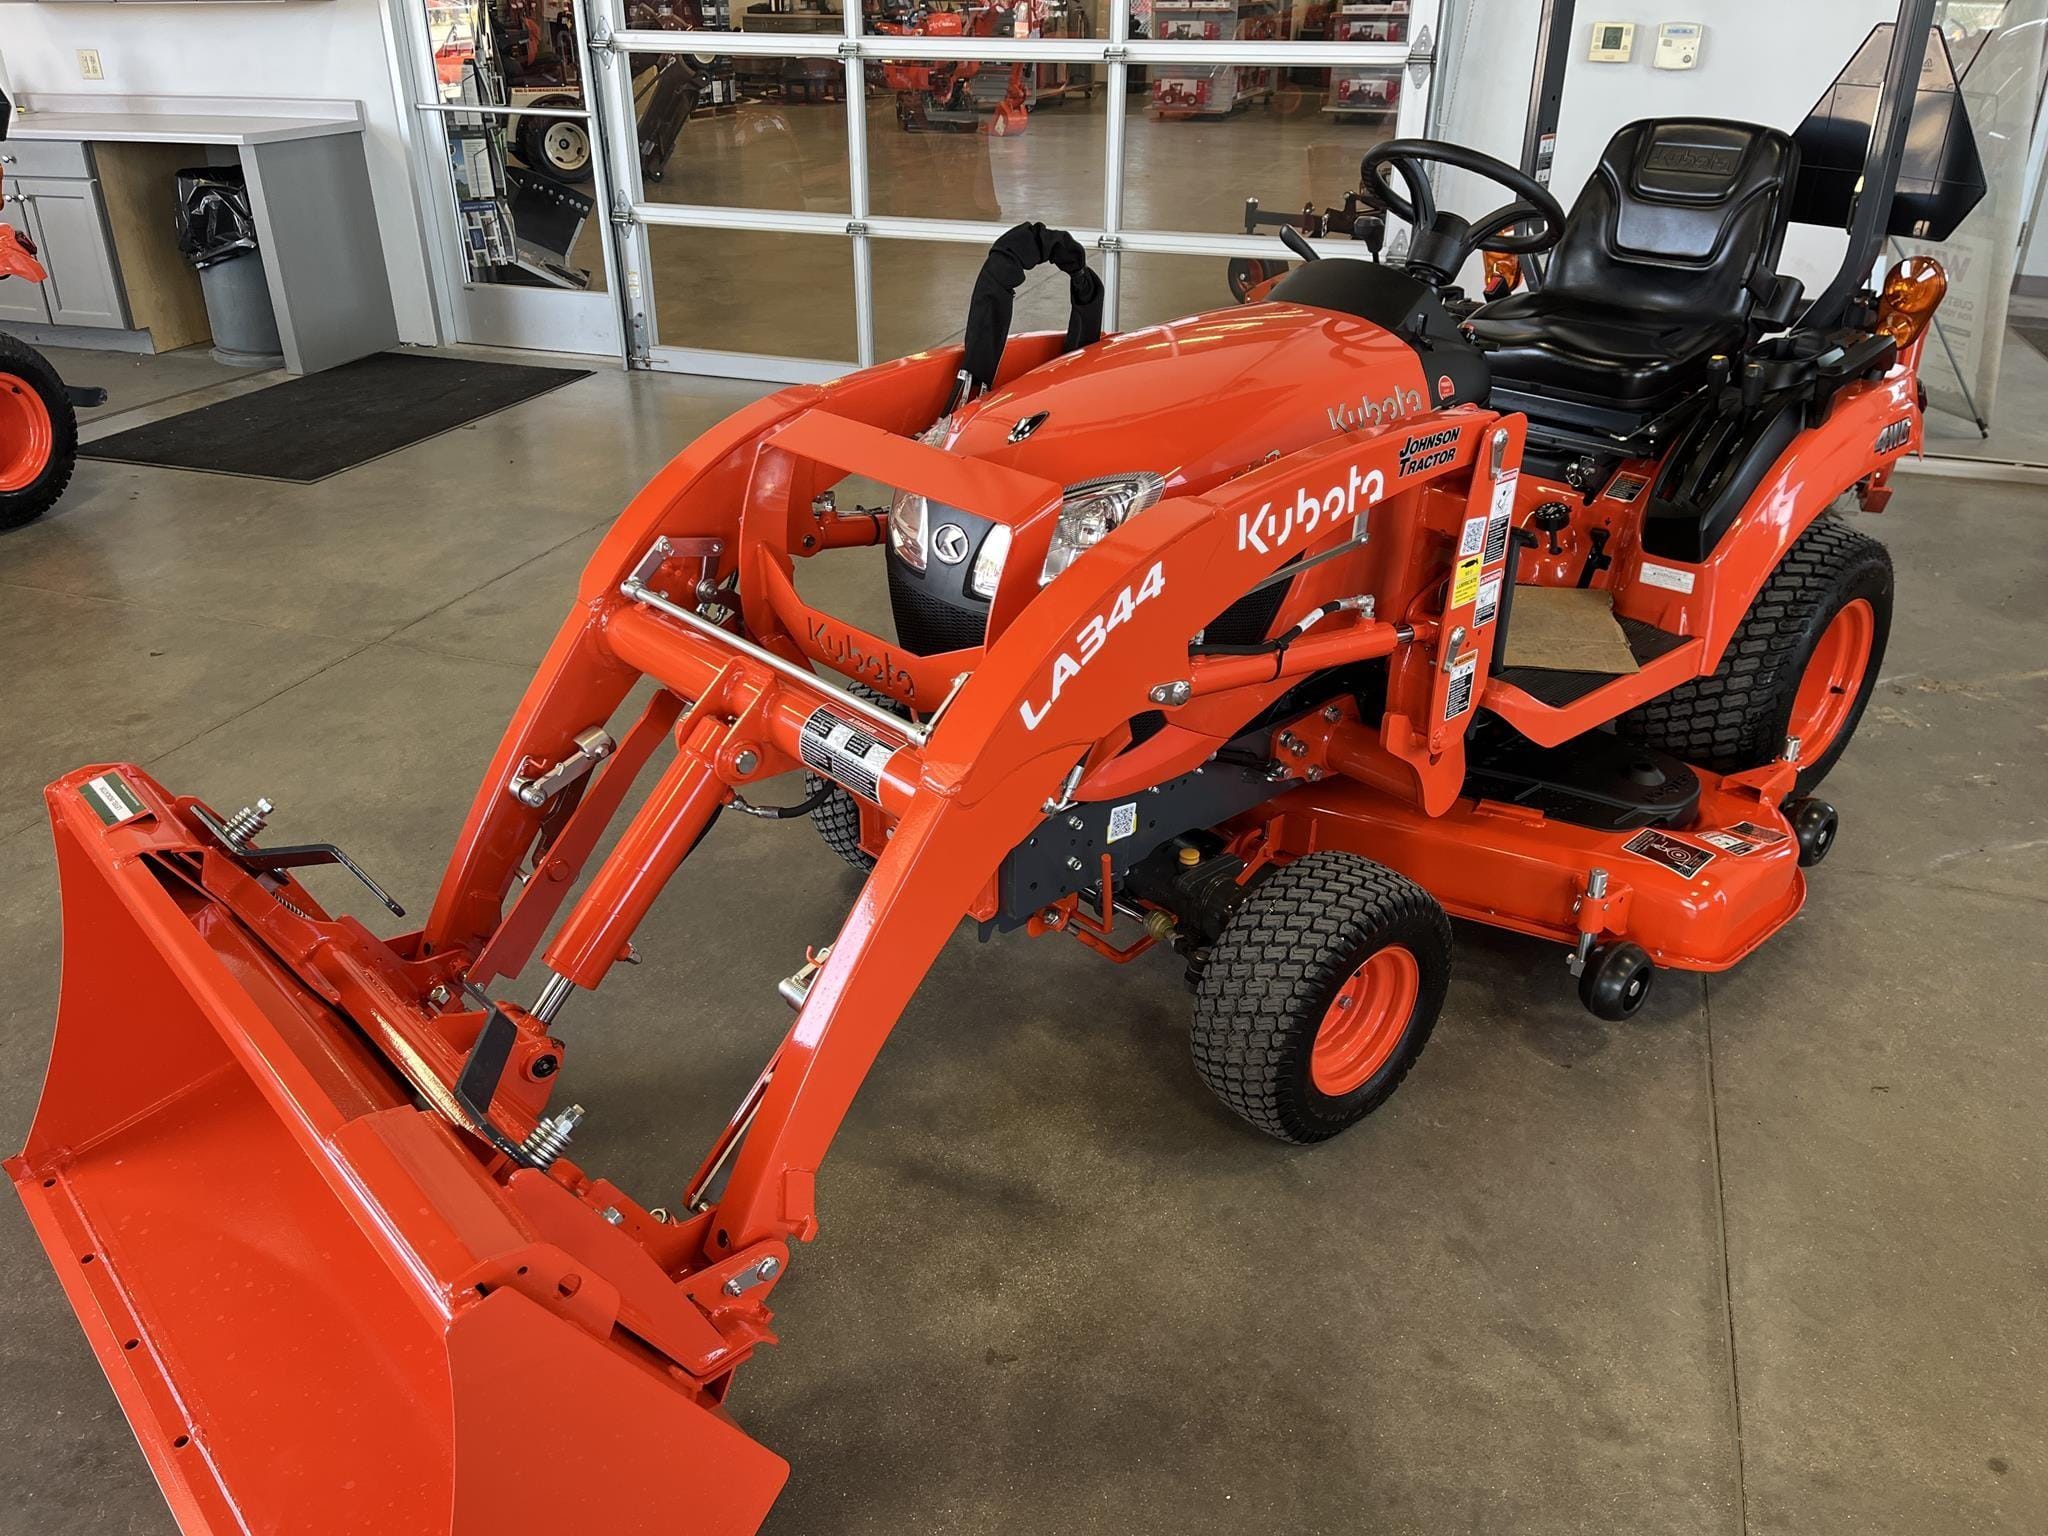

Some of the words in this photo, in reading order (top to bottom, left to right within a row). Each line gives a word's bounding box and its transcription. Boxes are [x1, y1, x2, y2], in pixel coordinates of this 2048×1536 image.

[1327, 384, 1422, 433] Kubota
[1399, 427, 1460, 458] JOHNSON
[1399, 447, 1457, 478] TRACTOR
[1238, 465, 1384, 554] Kubota
[808, 617, 916, 698] Kubota
[1019, 561, 1166, 731] LA344
